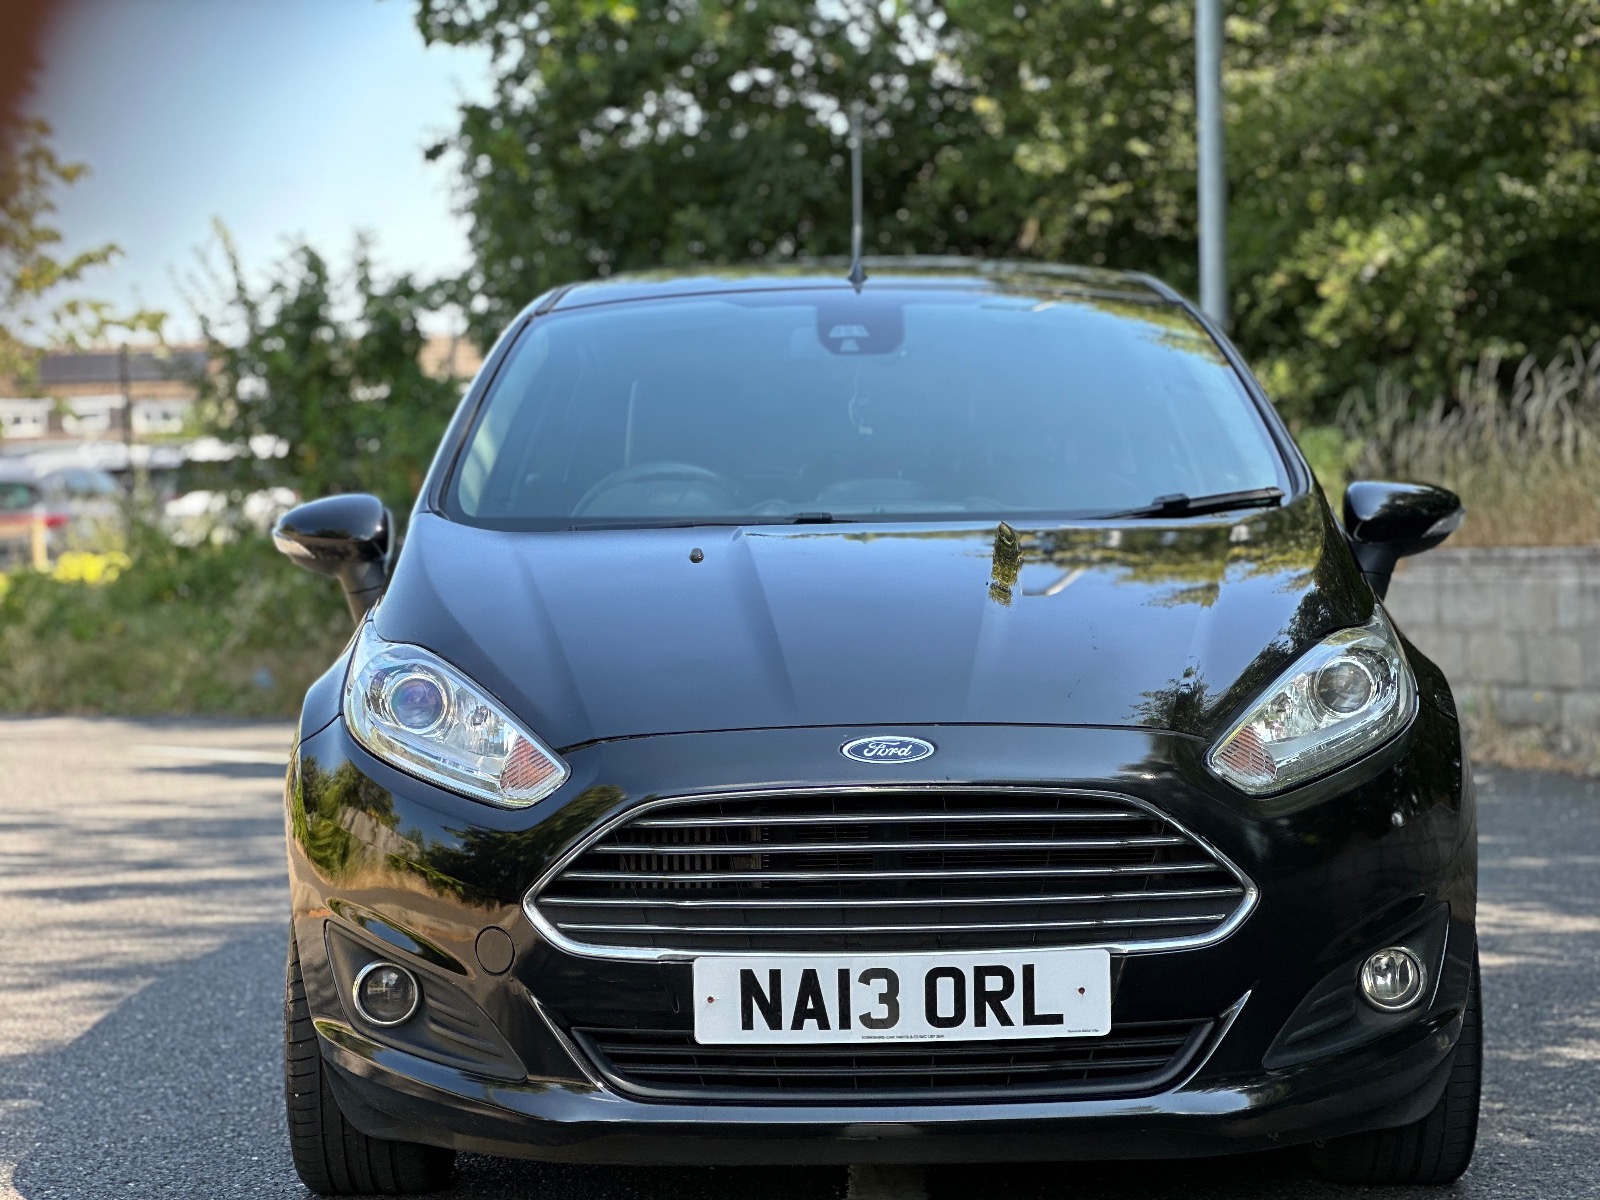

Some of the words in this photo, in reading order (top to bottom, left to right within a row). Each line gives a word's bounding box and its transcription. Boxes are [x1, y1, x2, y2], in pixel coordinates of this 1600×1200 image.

[863, 741, 912, 757] Ford
[740, 967, 900, 1031] NA13
[924, 964, 1064, 1028] ORL
